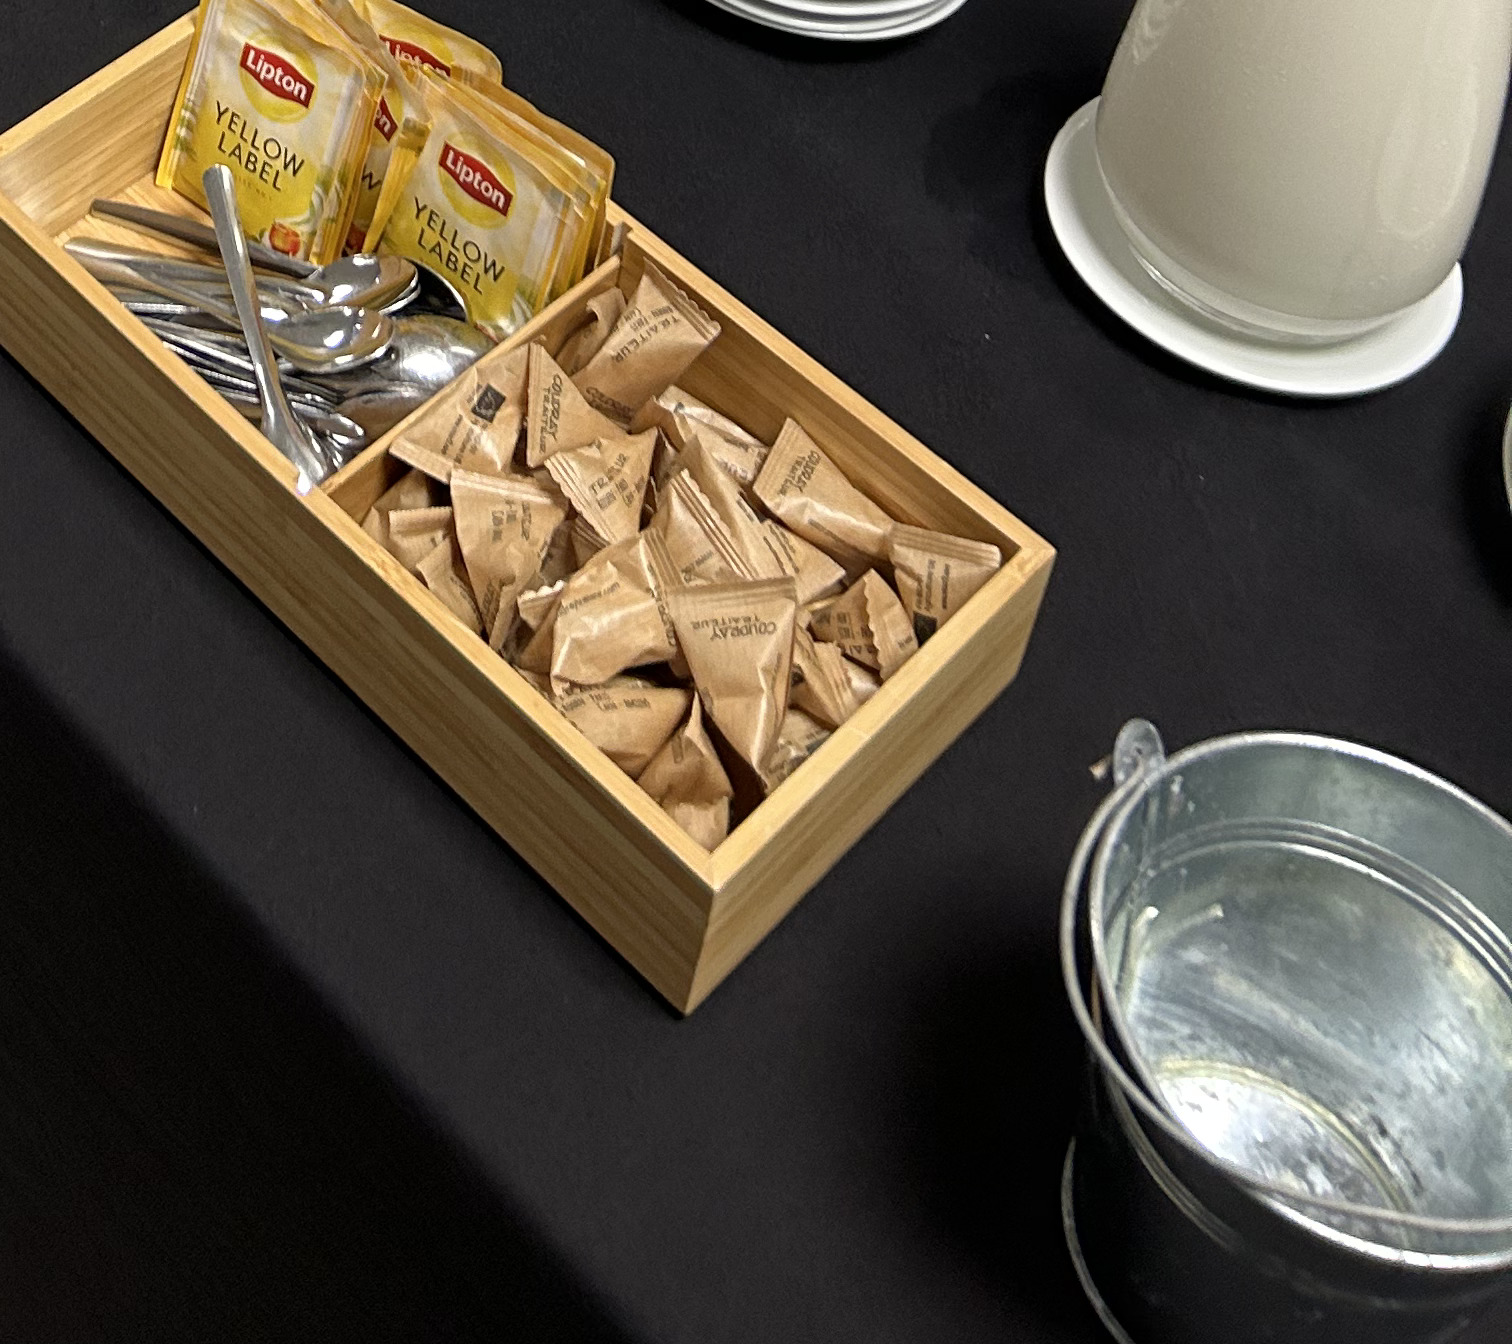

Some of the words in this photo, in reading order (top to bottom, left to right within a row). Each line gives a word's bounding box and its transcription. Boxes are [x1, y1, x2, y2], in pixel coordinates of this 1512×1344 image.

[246, 48, 309, 102] Lipton
[215, 99, 305, 178] YELLOW
[217, 130, 282, 192] LABEL
[444, 149, 506, 210] Lipton
[414, 196, 505, 283] YELLOW
[418, 226, 483, 296] LABEL
[709, 621, 777, 642] COUDRAY
